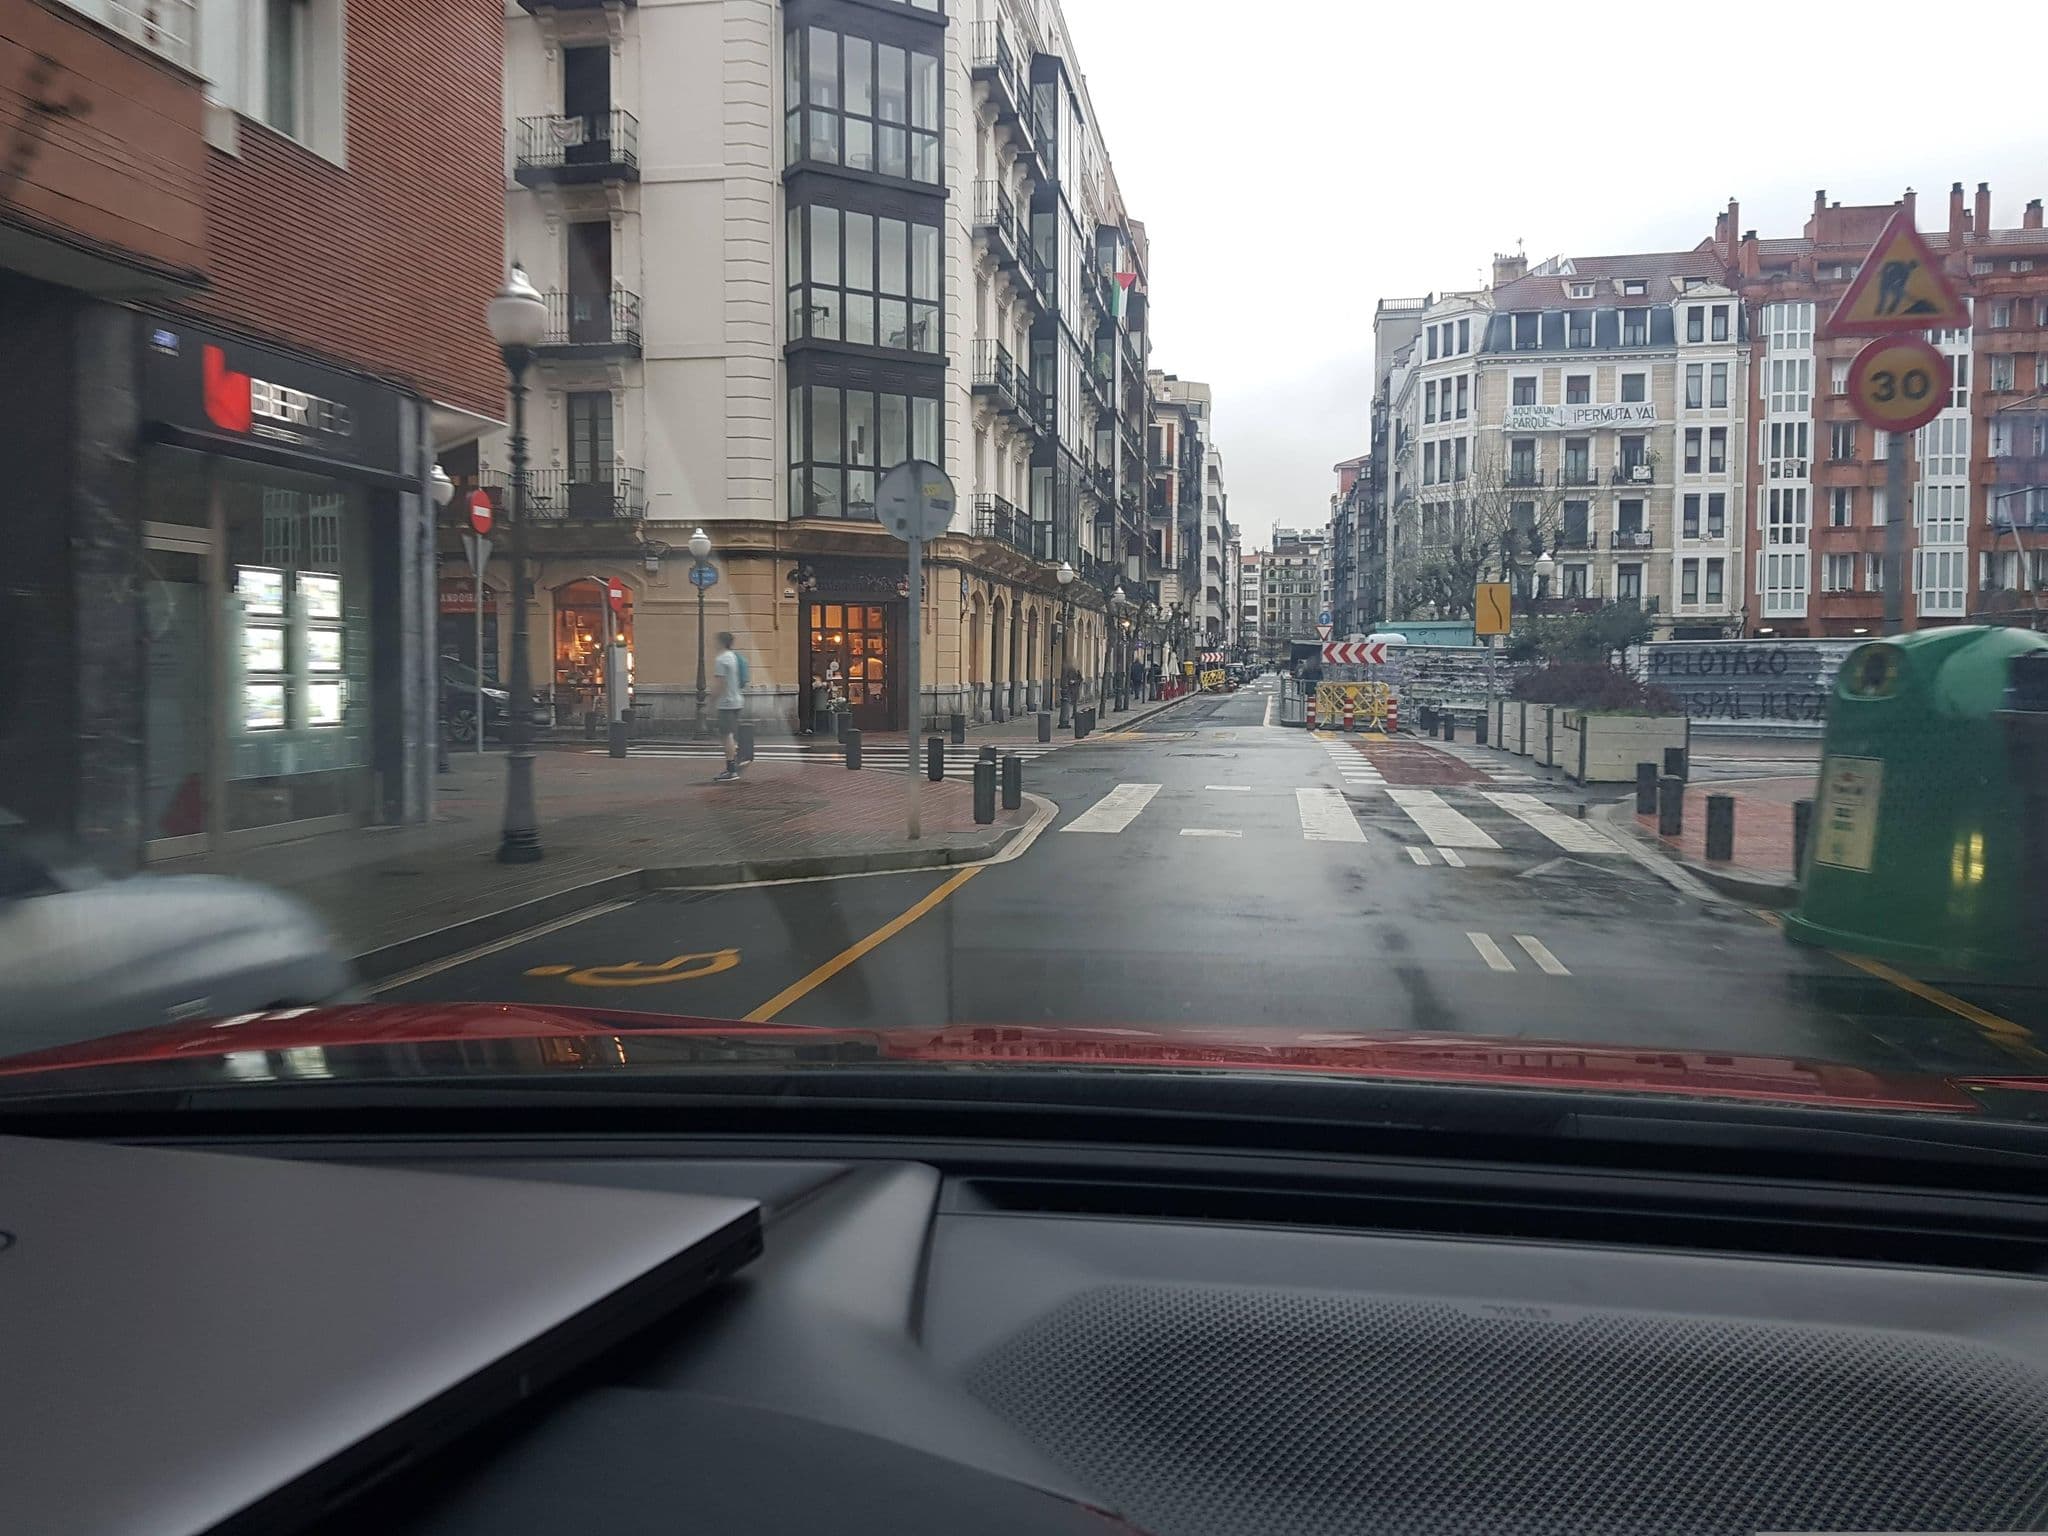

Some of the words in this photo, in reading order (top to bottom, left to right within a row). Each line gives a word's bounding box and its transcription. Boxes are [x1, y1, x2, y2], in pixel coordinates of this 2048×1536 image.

[1870, 368, 1931, 402] 30
[1512, 416, 1551, 429] PARQUE
[1636, 407, 1655, 419] YA!
[1762, 691, 1827, 720] ILEGA
